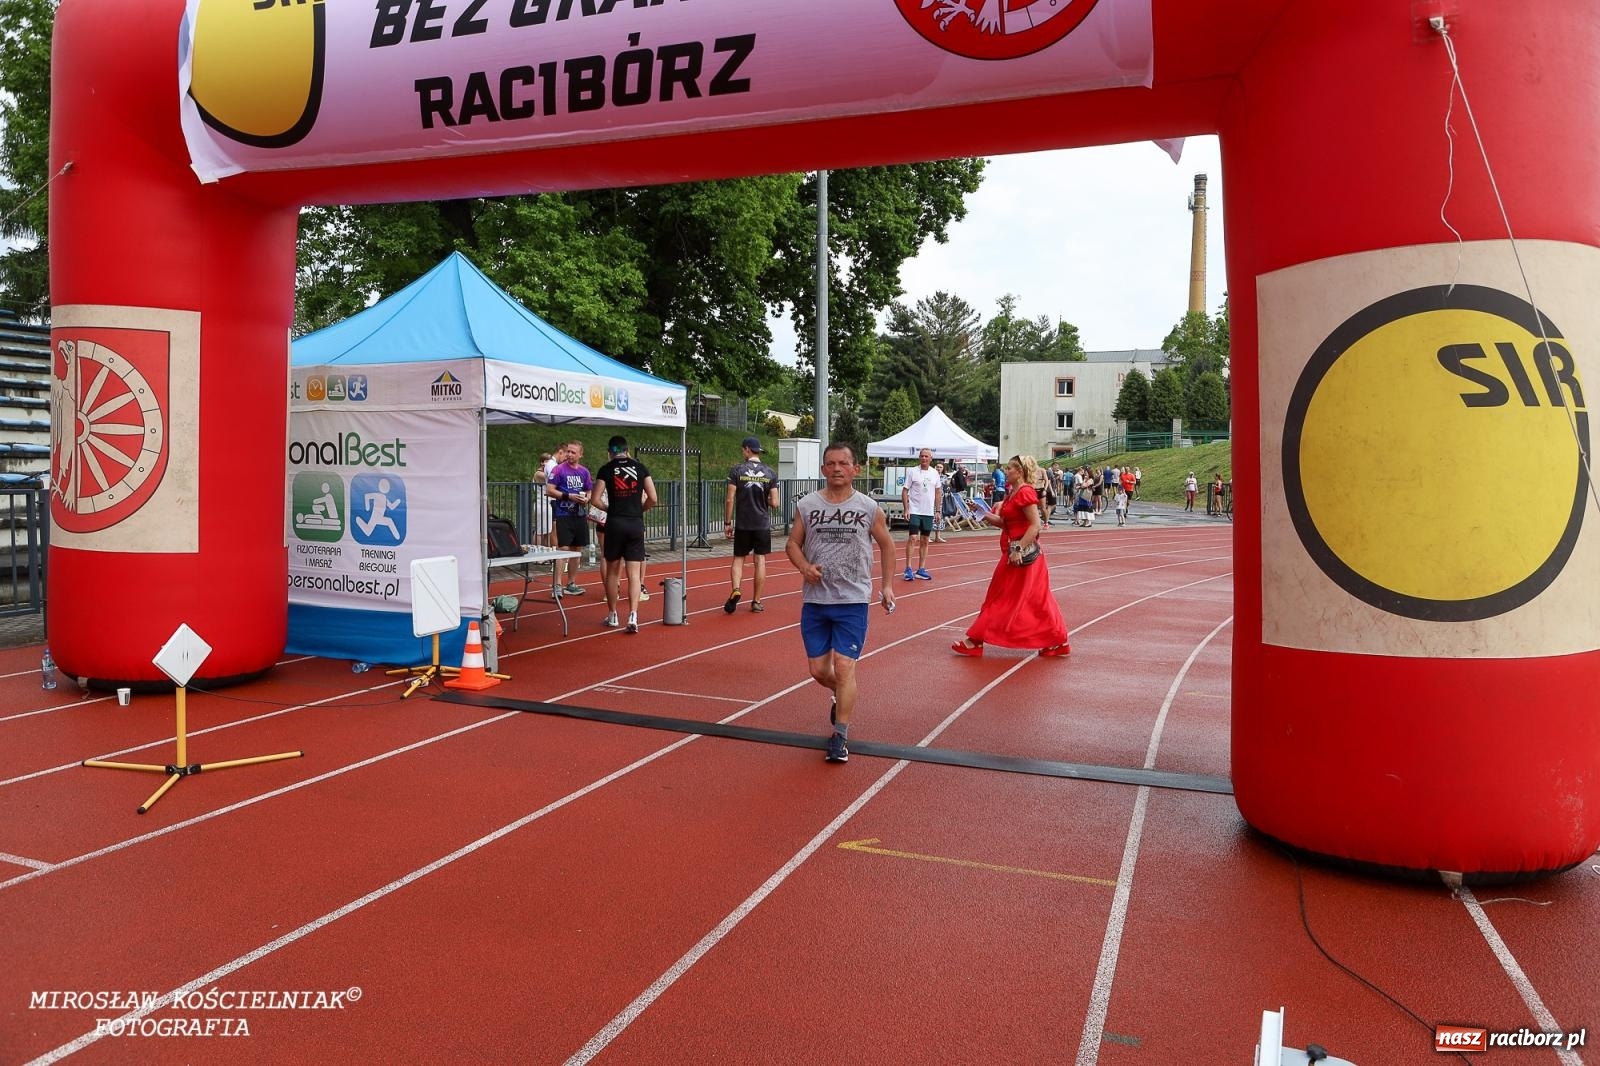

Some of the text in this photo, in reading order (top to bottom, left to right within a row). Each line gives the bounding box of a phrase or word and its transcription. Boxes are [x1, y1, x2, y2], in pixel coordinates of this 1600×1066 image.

[370, 0, 489, 48] BEZ
[414, 32, 757, 129] RACIBÓRZ
[1436, 341, 1586, 408] SIR
[431, 383, 462, 397] MITKO
[502, 374, 587, 406] PersonalBest
[808, 508, 868, 528] BLACK
[296, 545, 342, 557] FIZJOTERAPIA
[360, 549, 396, 560] TRENINGI
[309, 558, 333, 569] MASAŻ
[359, 561, 397, 574] BIEGOWE
